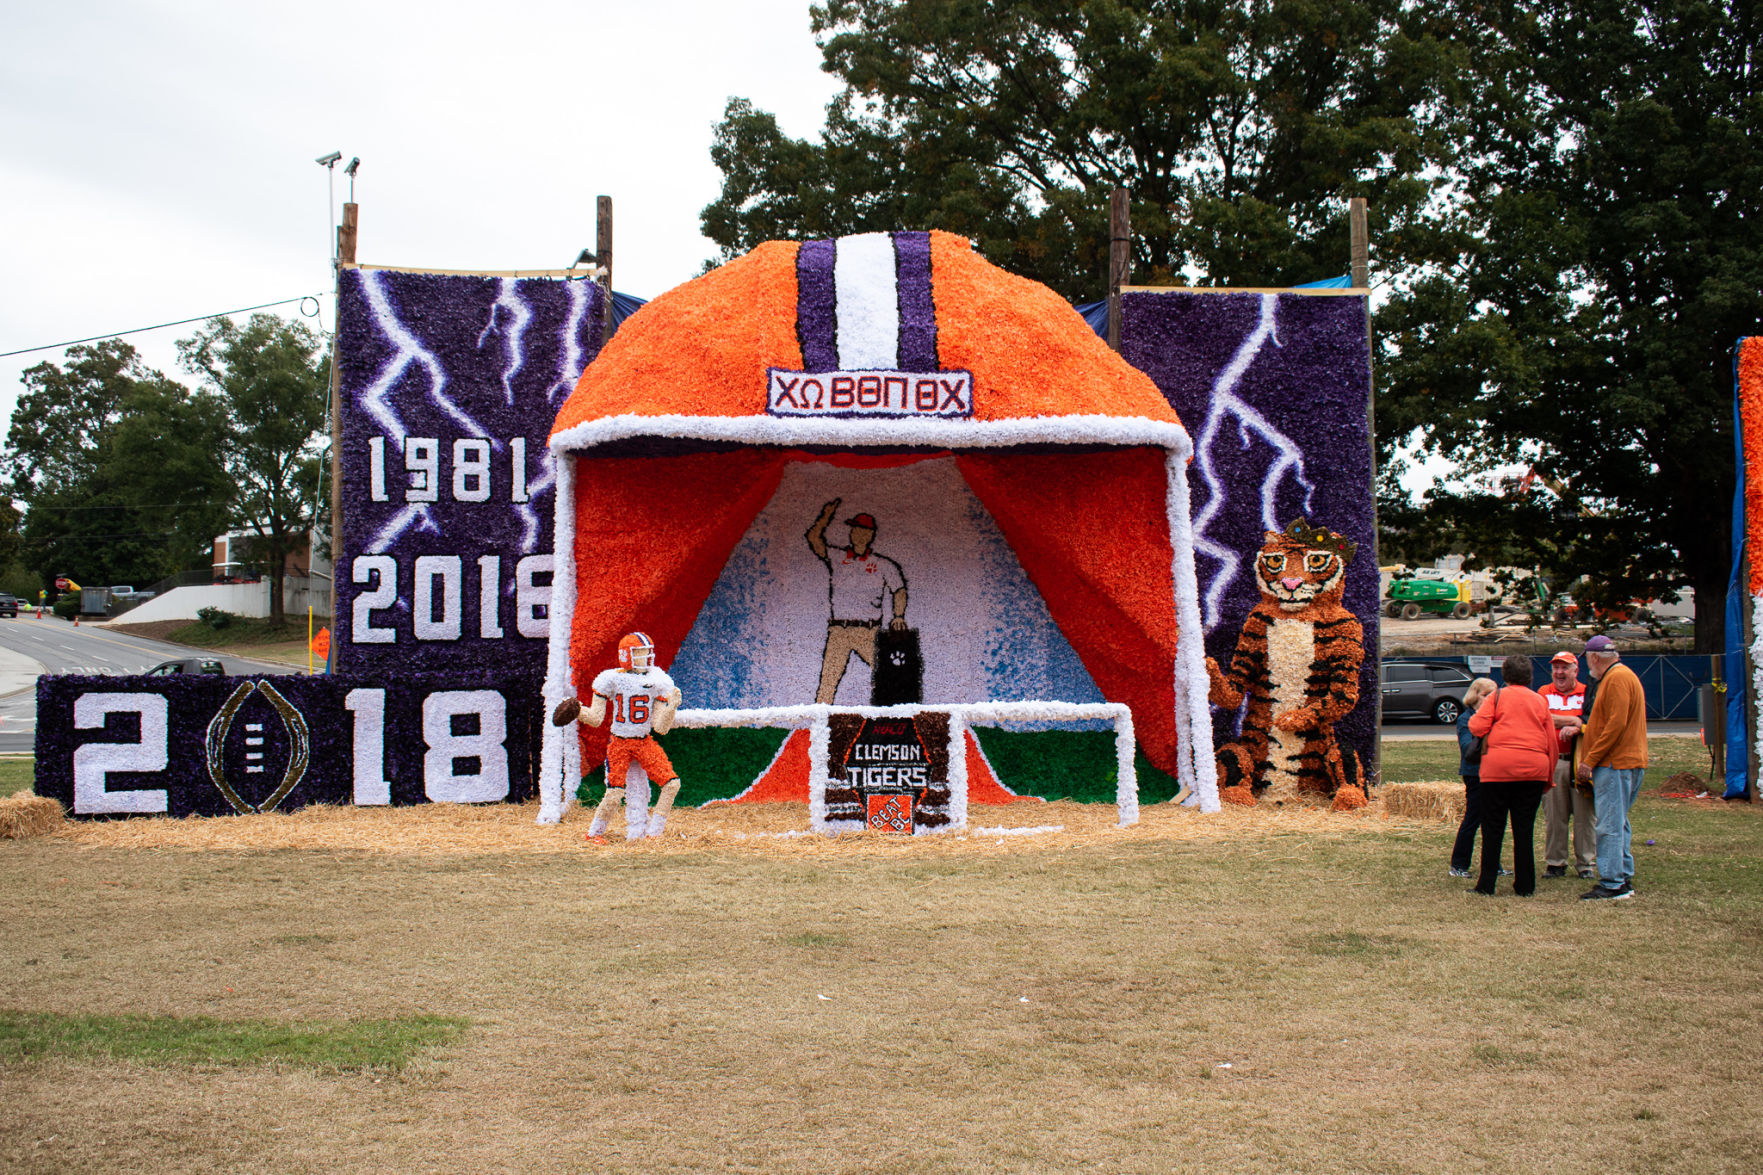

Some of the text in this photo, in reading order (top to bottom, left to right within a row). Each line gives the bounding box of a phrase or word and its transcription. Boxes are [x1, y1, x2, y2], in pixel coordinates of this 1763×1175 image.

[368, 436, 529, 502] 1981
[352, 553, 554, 643] 2016
[615, 693, 649, 724] 16
[855, 744, 920, 760] CLEMSON
[847, 767, 927, 787] TIGERS
[871, 796, 901, 828] BEAT
[889, 811, 910, 830] BC
